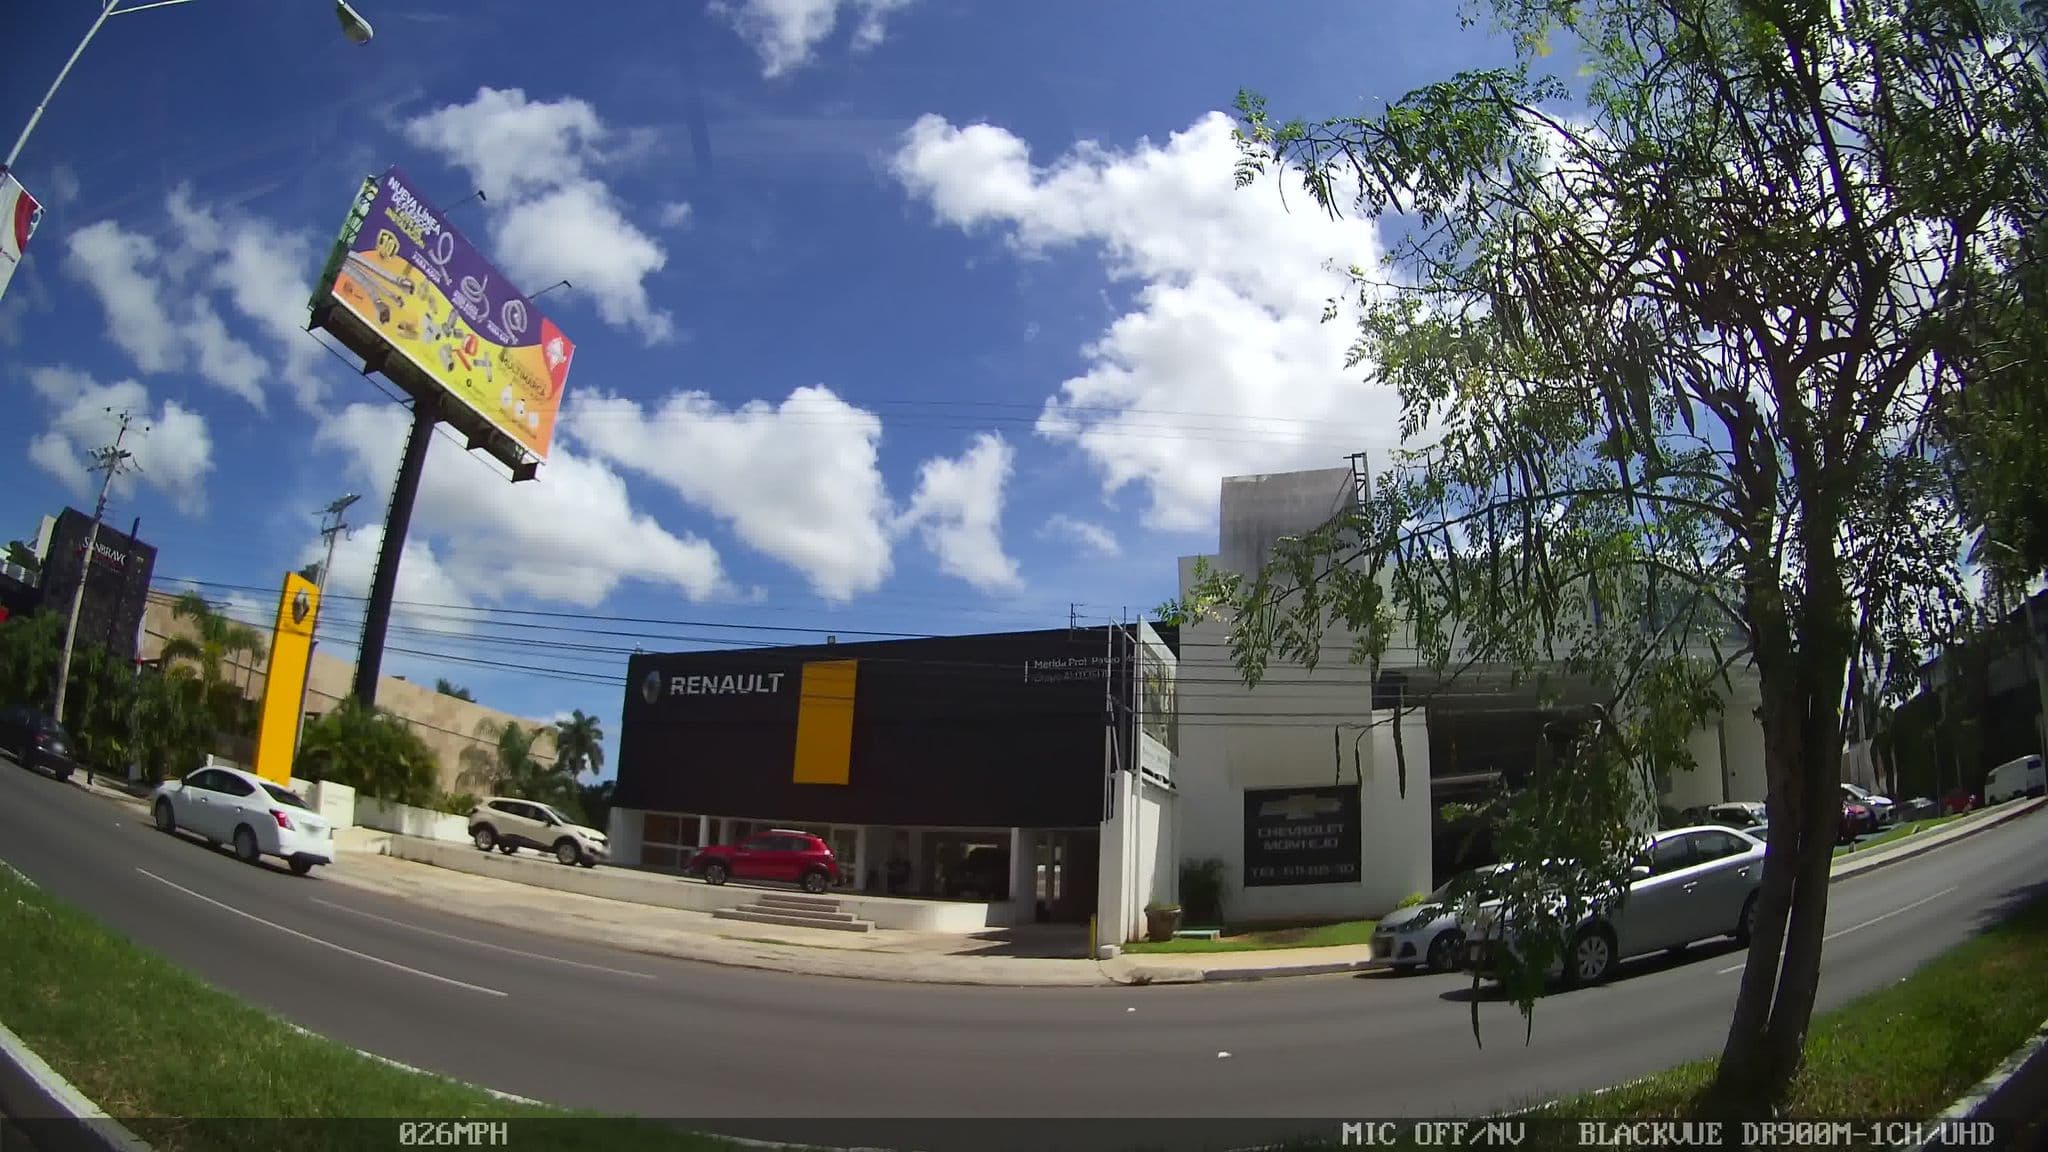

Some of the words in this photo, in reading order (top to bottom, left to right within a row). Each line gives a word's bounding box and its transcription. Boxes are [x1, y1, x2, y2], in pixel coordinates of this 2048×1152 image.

[388, 176, 418, 212] NUEVA
[83, 537, 127, 566] SNBRAV
[670, 673, 785, 695] RENAULT
[1257, 823, 1345, 839] CHEVROLET
